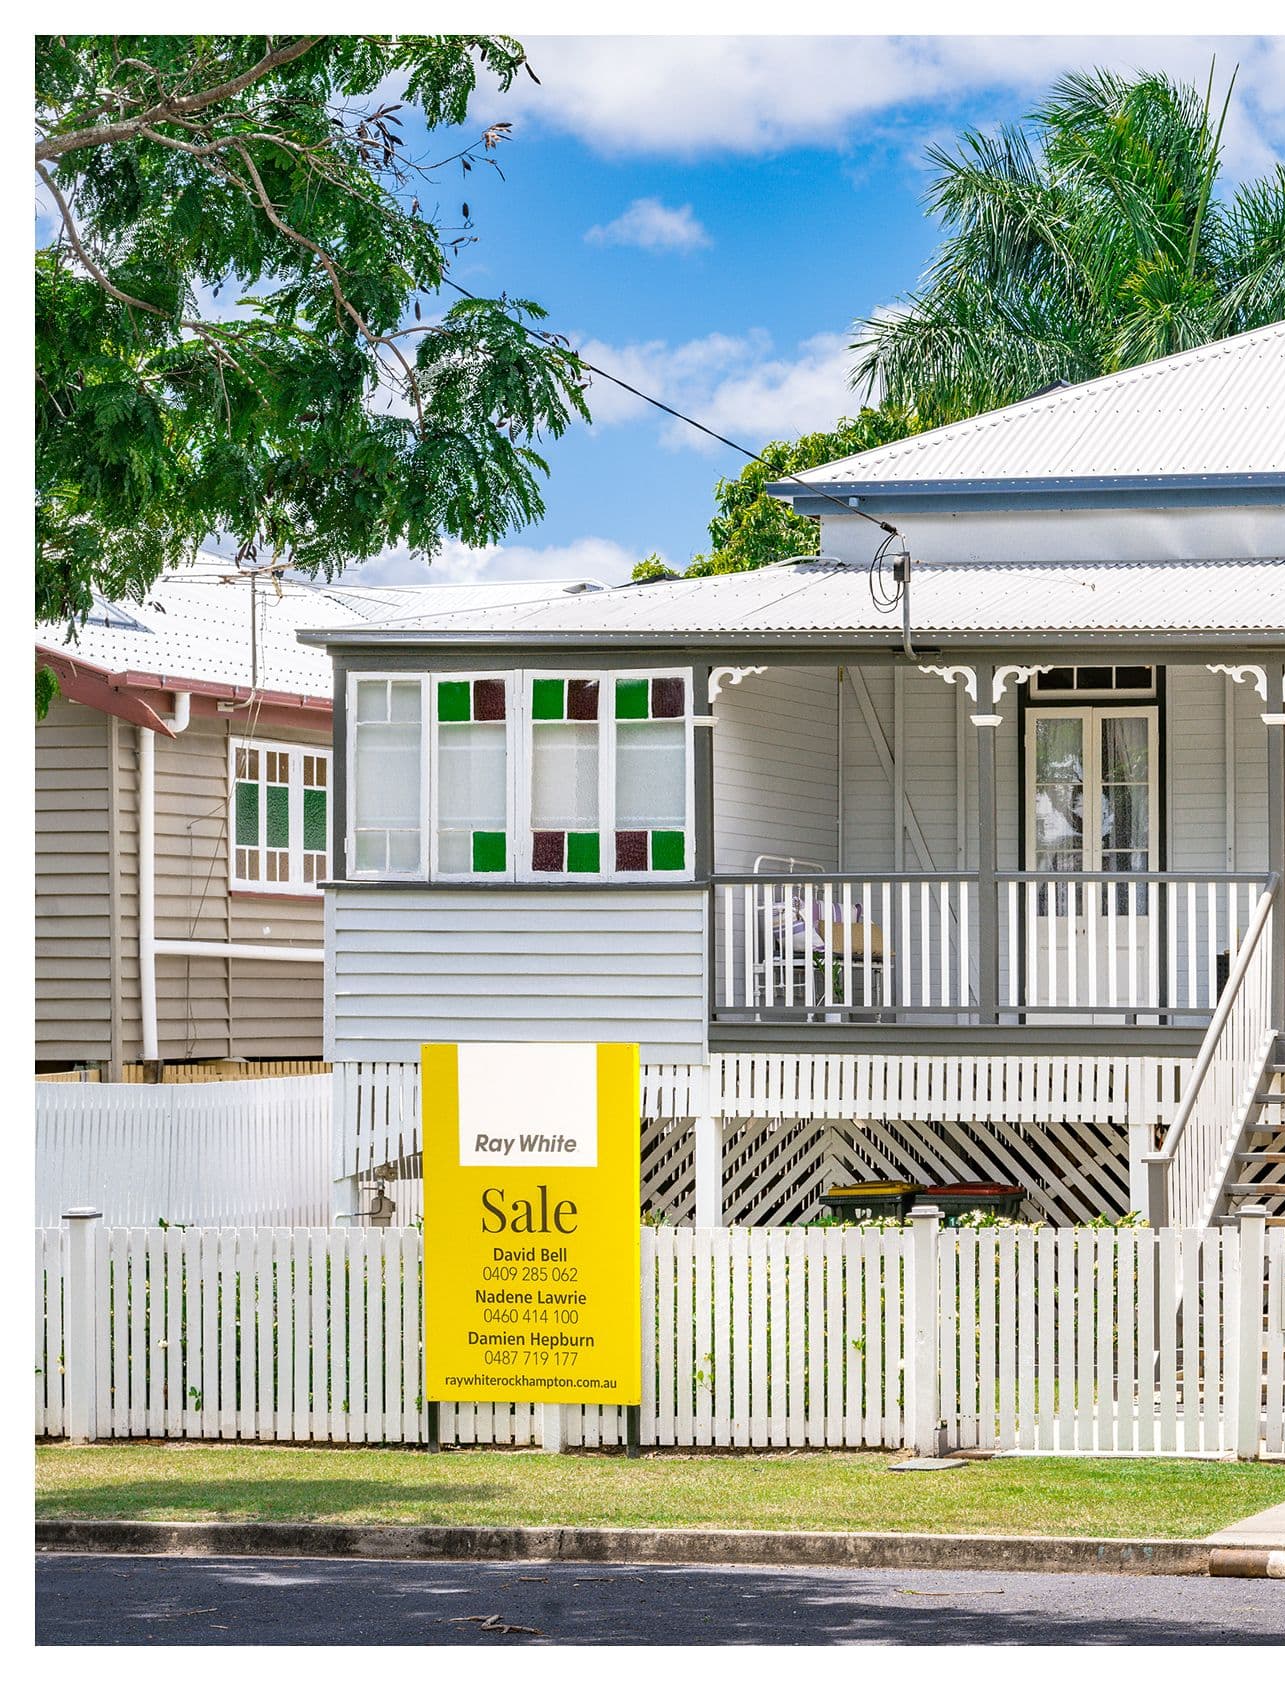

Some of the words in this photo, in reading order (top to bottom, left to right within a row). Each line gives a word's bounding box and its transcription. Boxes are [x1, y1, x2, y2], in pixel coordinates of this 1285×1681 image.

[475, 1133, 516, 1156] Ray
[520, 1134, 577, 1153] White
[482, 1185, 578, 1234] Sale
[493, 1246, 536, 1262] David
[541, 1247, 567, 1262] Bell
[482, 1266, 518, 1282] 0409
[522, 1266, 548, 1282] 285
[552, 1267, 578, 1282] 062
[475, 1289, 533, 1304] Nadene
[537, 1290, 587, 1305] Lawrie
[483, 1308, 519, 1324] 0460
[523, 1309, 549, 1324] 414
[553, 1309, 579, 1325] 100
[468, 1330, 526, 1347] Damien
[530, 1331, 595, 1350] Hepburn
[484, 1350, 519, 1366] 0487
[523, 1350, 550, 1366] 719
[554, 1350, 579, 1366] 177
[445, 1373, 617, 1390] raywhiterockhampton.com.au
